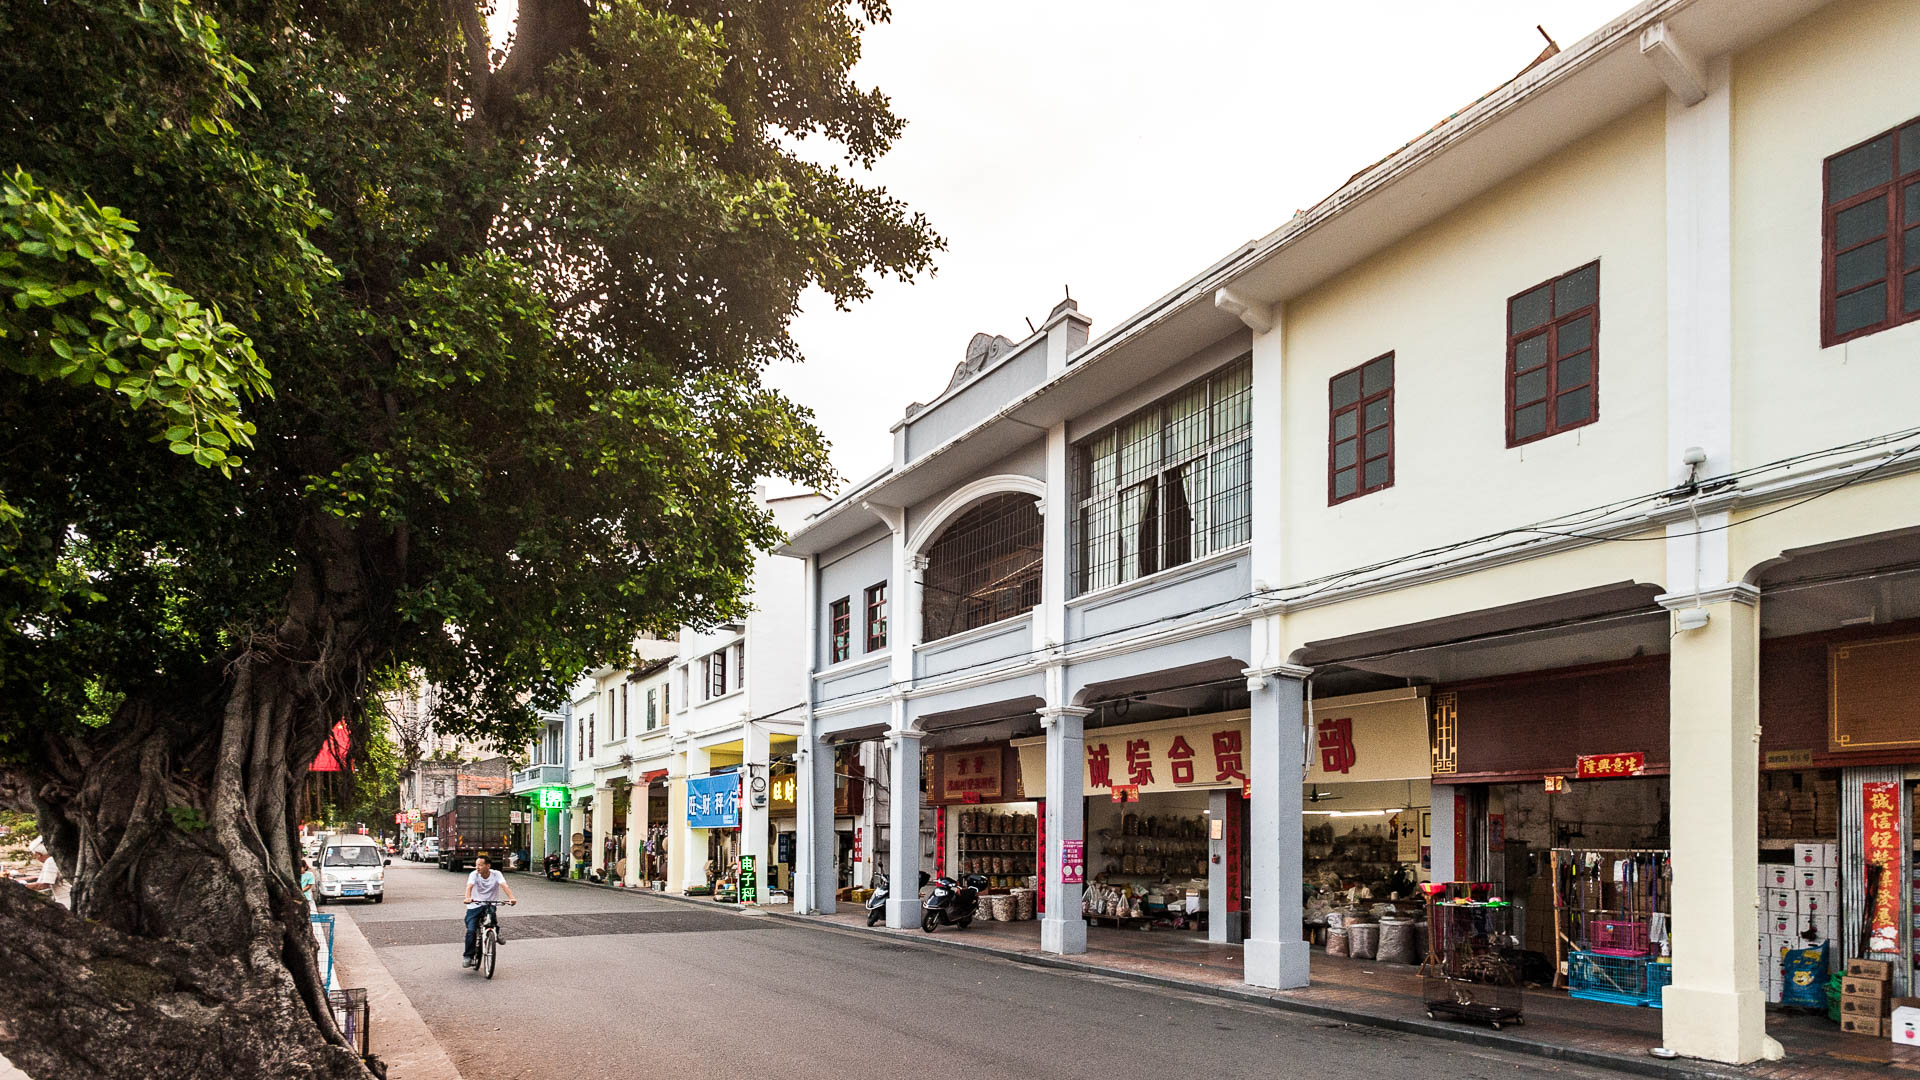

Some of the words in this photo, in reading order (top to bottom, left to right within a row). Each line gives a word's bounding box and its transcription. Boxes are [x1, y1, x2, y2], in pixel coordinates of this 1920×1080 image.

[688, 790, 738, 816] 旺财秤行
[773, 778, 797, 803] 旺财
[741, 856, 756, 902] 电子秤
